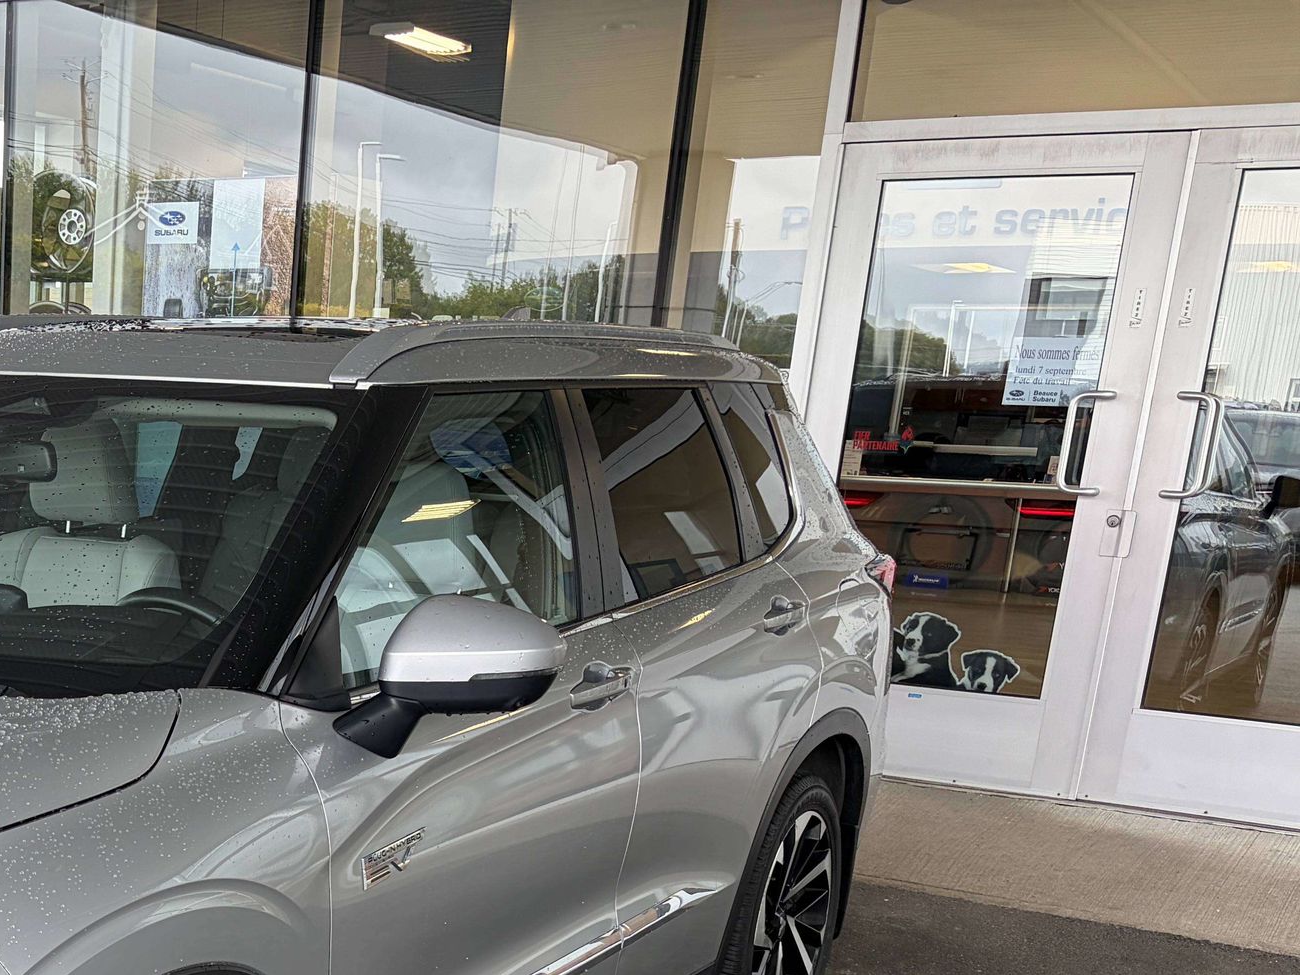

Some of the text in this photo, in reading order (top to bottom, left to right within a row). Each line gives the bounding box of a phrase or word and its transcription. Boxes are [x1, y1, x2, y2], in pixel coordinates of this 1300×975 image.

[932, 205, 977, 237] et
[154, 228, 189, 237] SUBARU
[1036, 349, 1071, 361] sommes
[1015, 365, 1036, 374] lundi
[1038, 366, 1044, 374] 7
[1032, 376, 1043, 385] du
